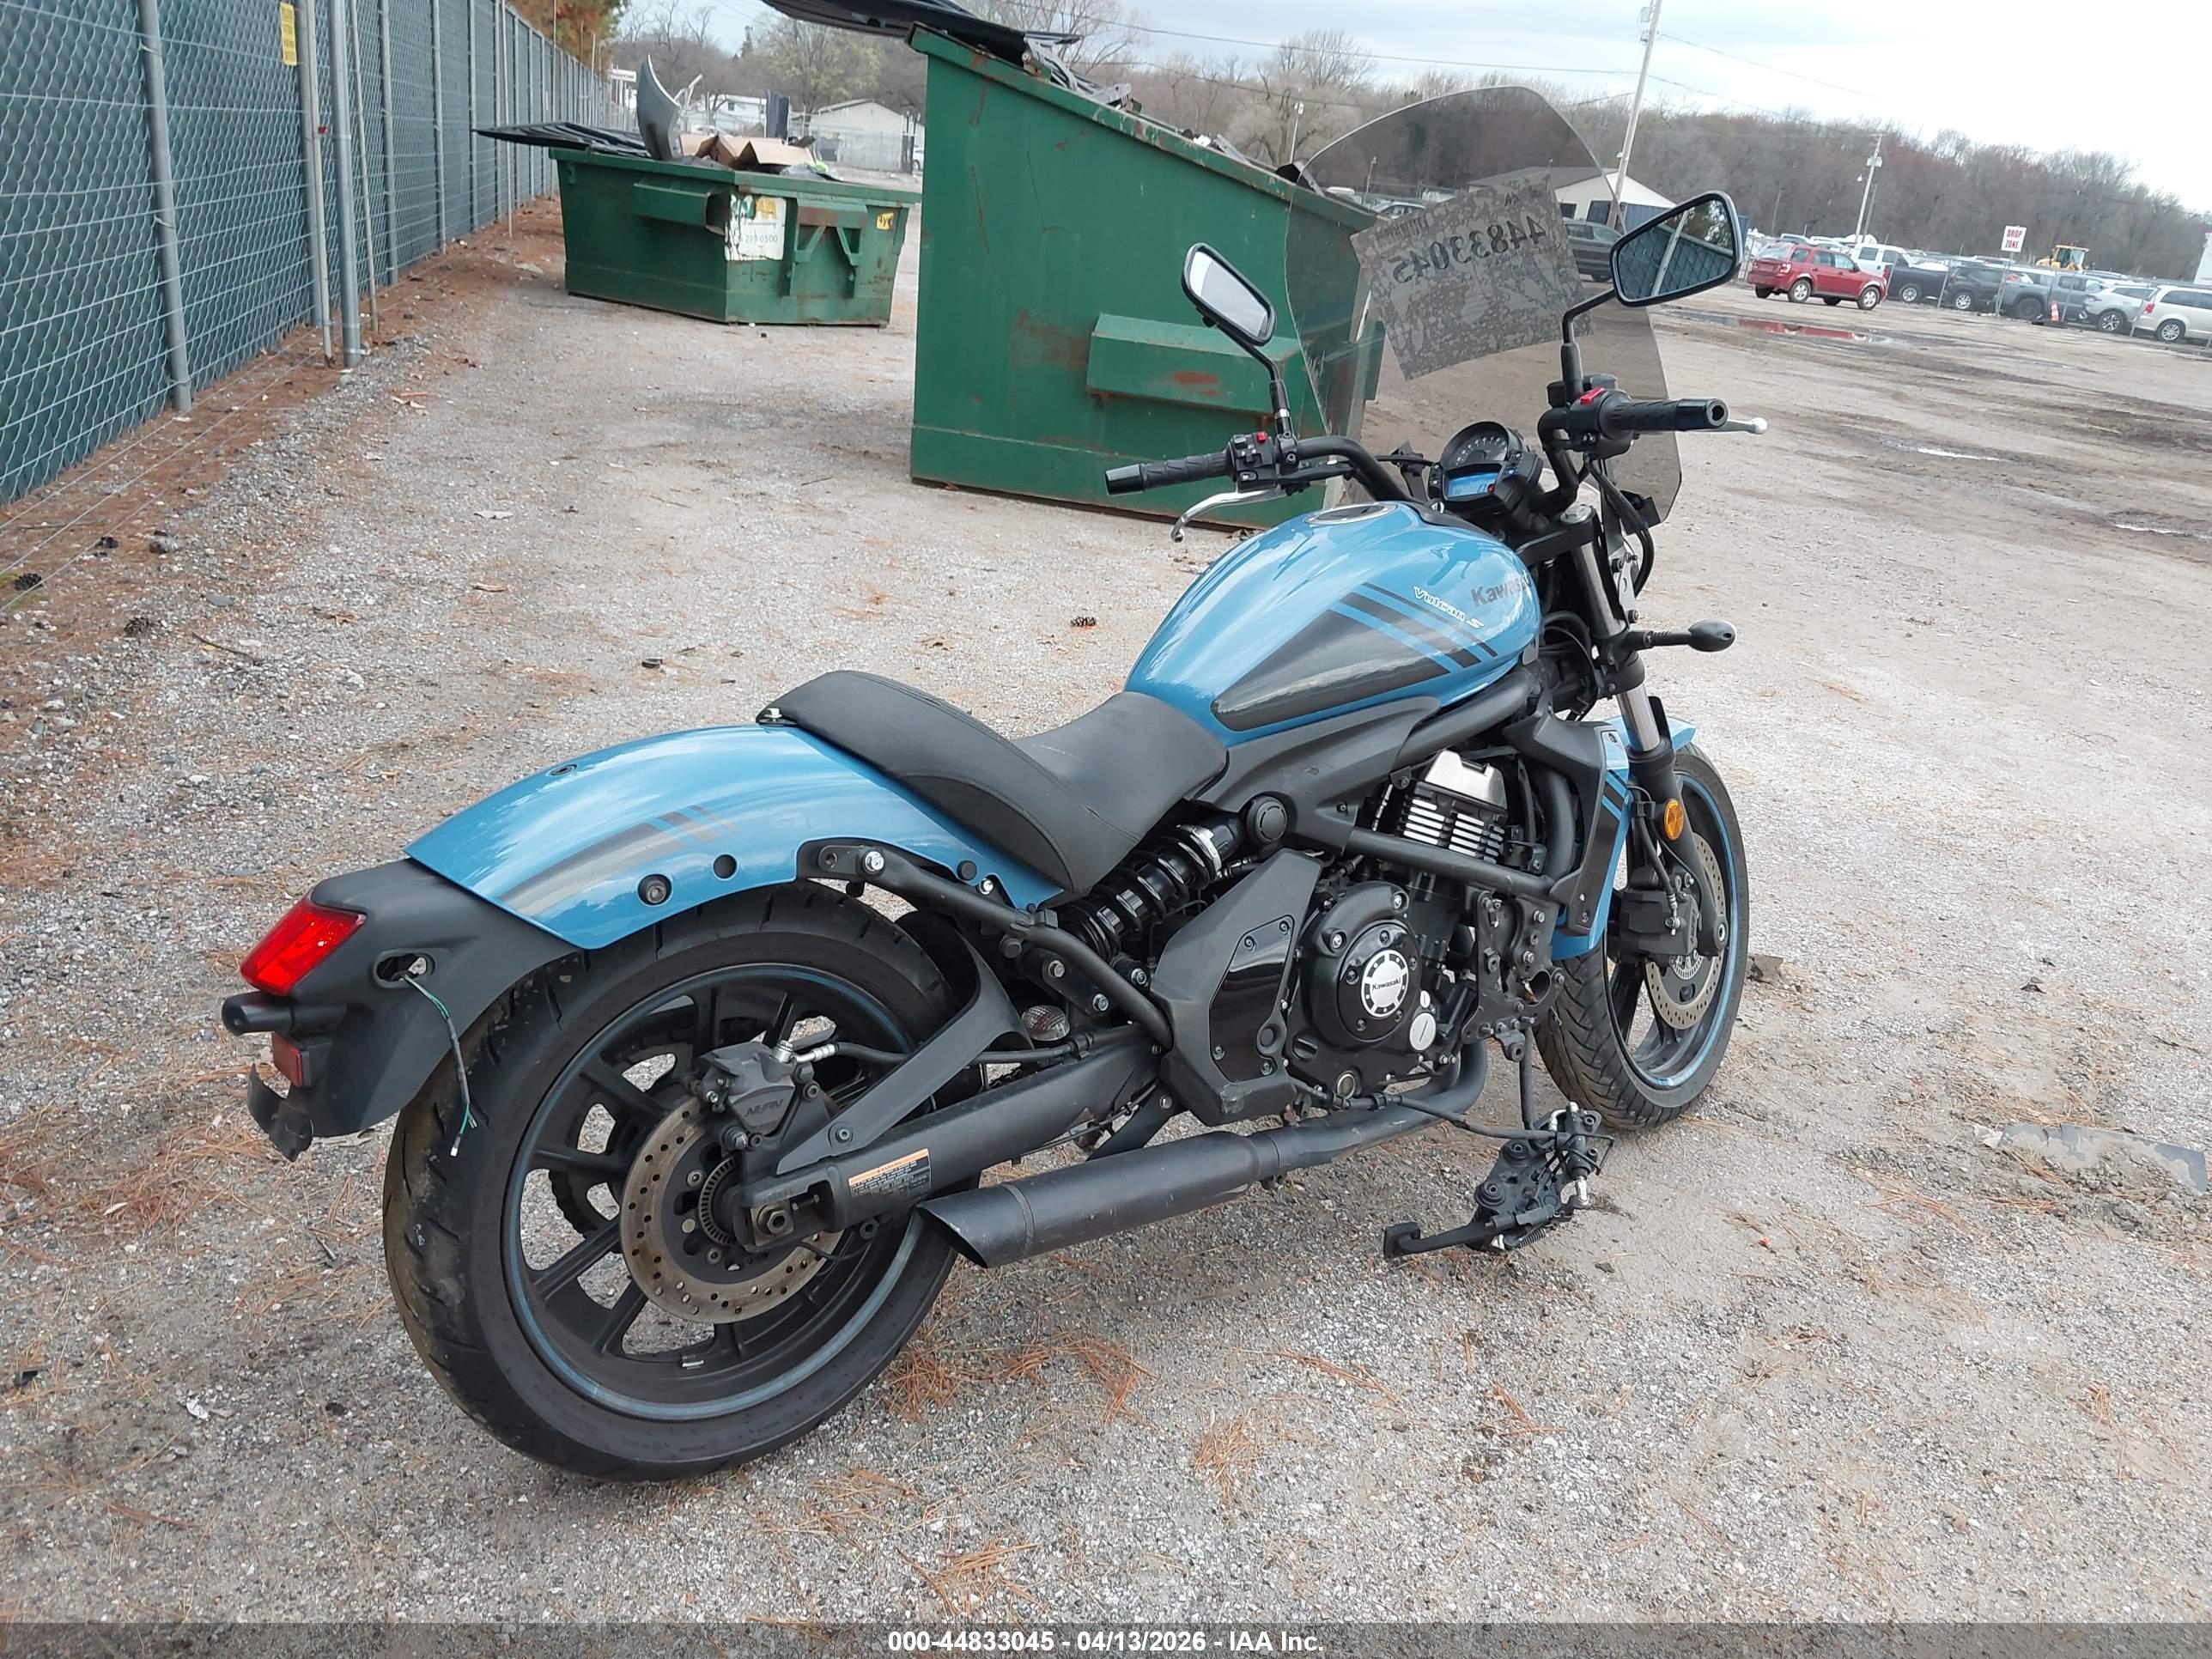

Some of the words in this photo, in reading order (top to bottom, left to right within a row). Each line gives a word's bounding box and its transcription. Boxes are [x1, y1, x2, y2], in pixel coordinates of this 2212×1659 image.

[2007, 228, 2023, 238] DROP
[2004, 240, 2021, 249] ZONE
[1413, 586, 1466, 623] Vulcan
[1465, 617, 1486, 629] S
[1371, 976, 1402, 991] Kawasaki
